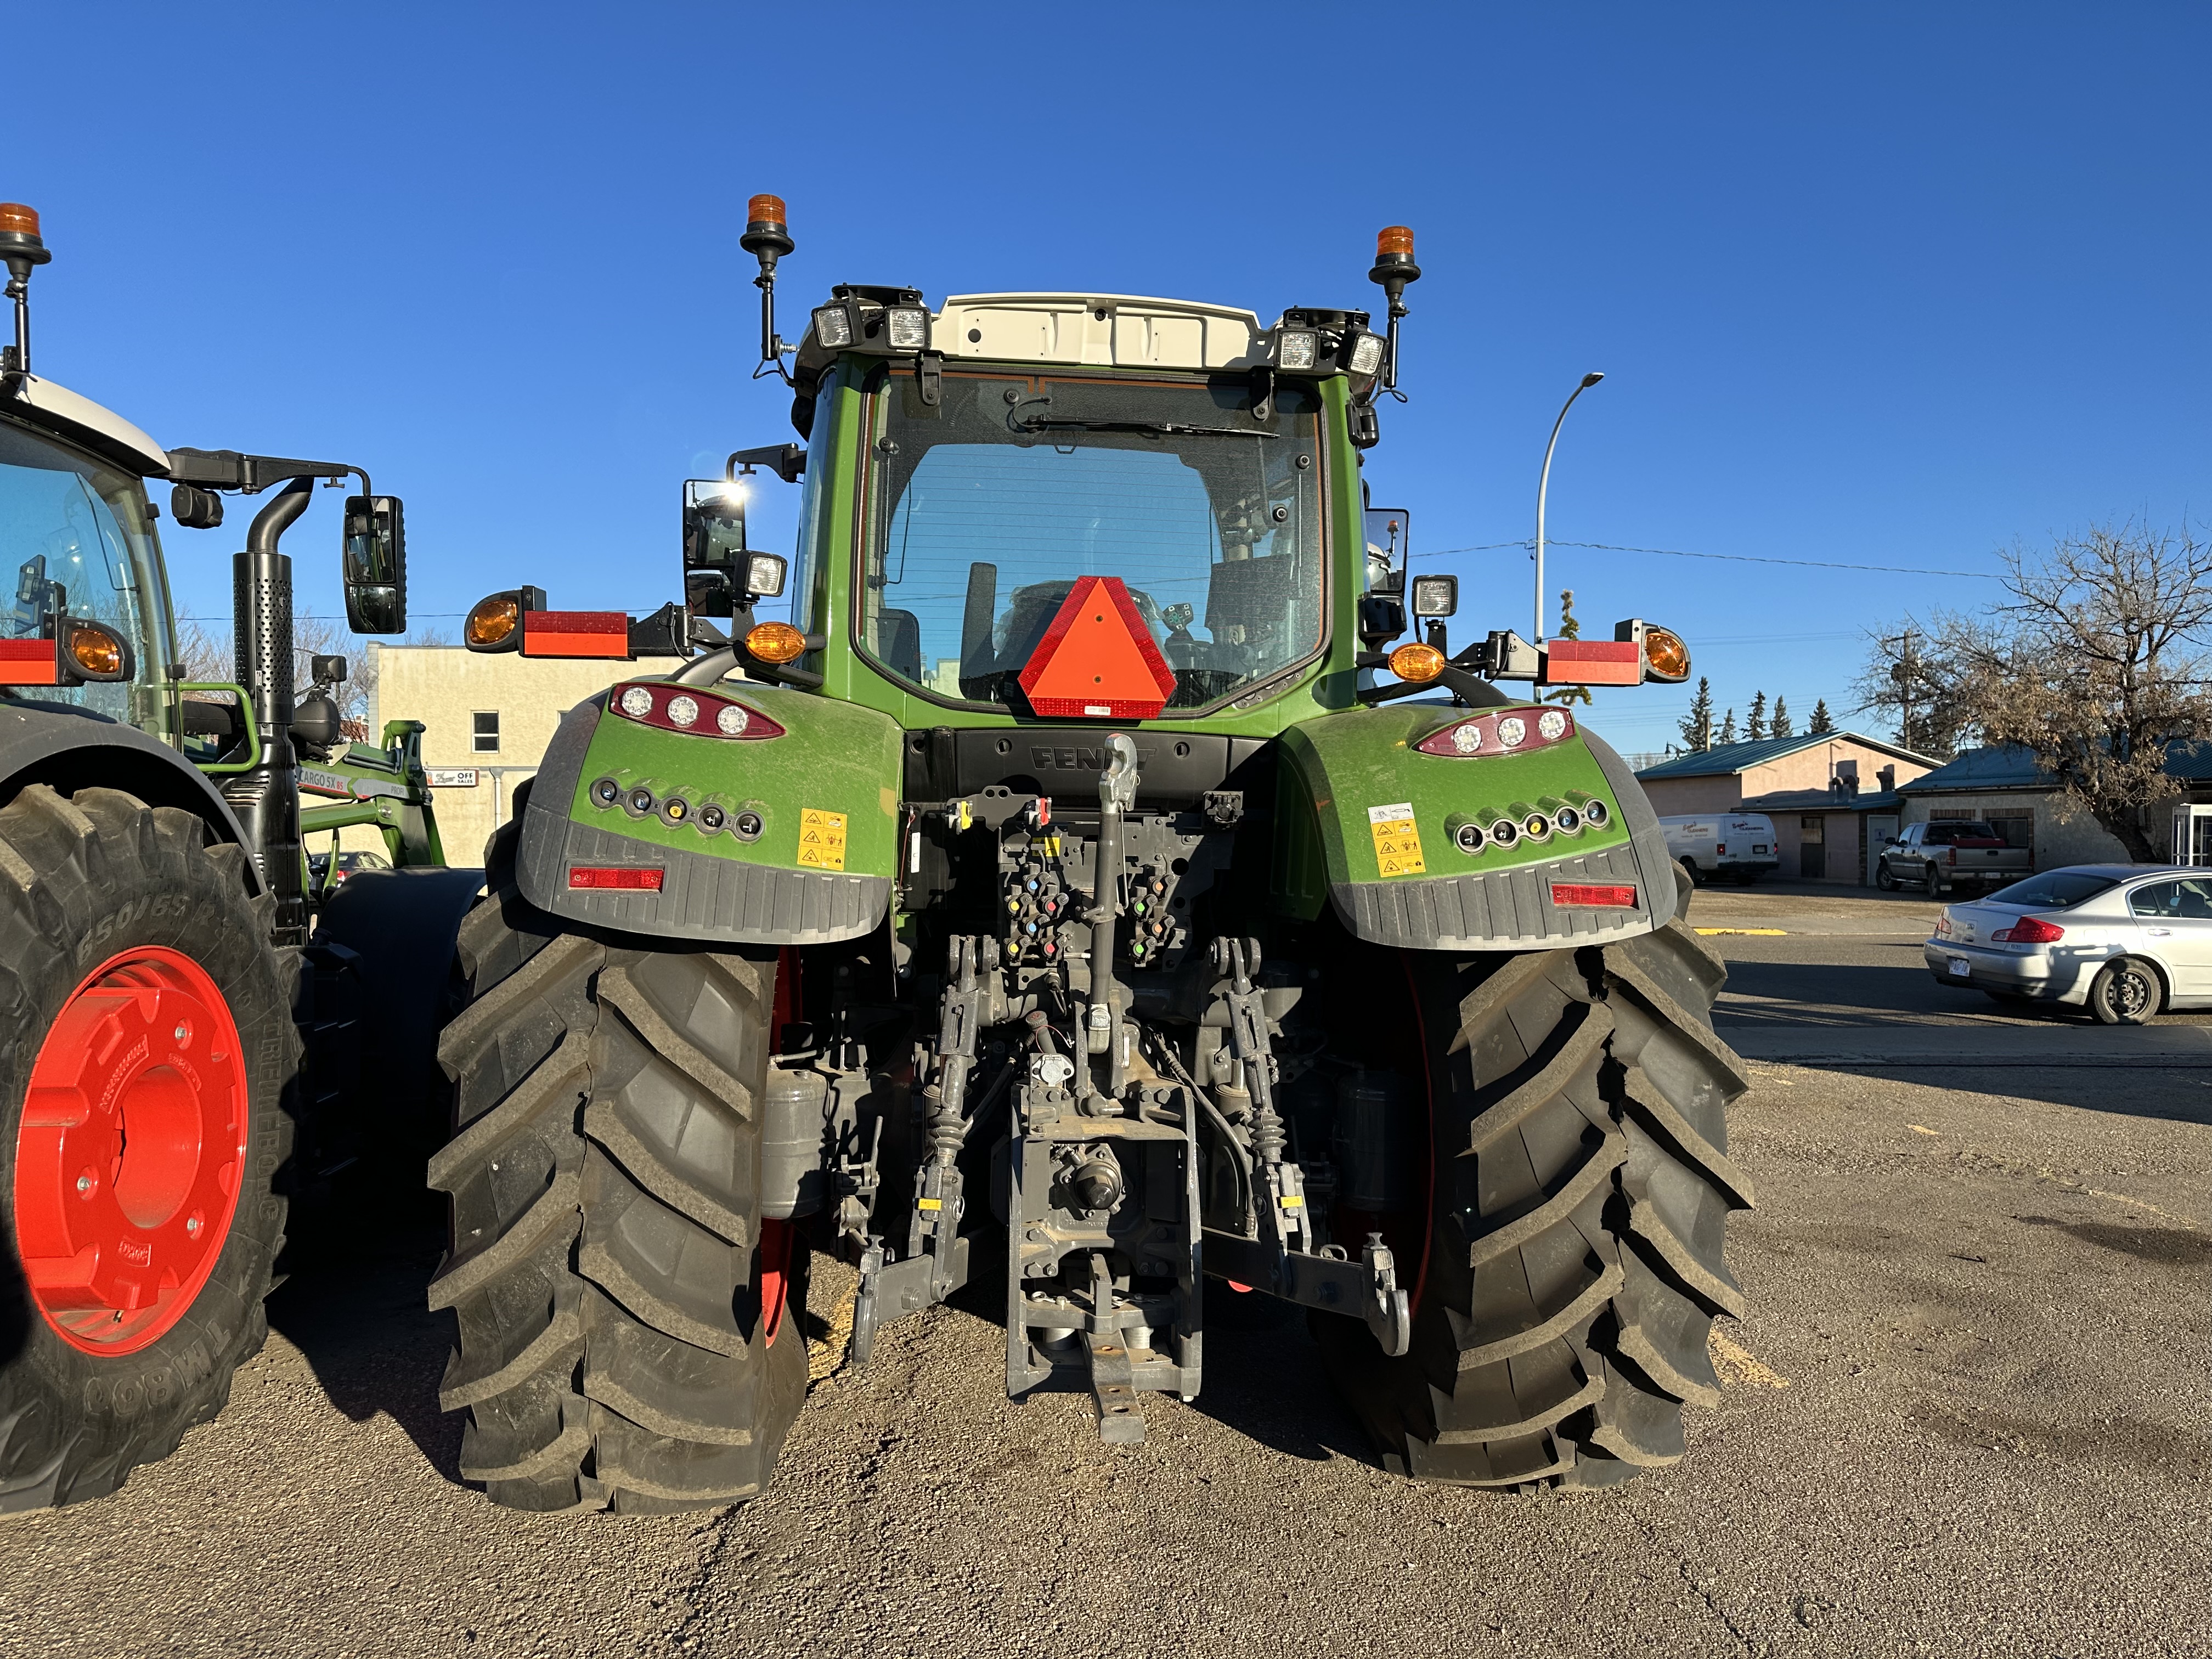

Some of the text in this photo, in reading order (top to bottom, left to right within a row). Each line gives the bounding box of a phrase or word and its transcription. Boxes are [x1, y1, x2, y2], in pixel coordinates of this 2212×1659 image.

[299, 770, 343, 791] CARGO 5X 85
[391, 785, 404, 796] PROFI
